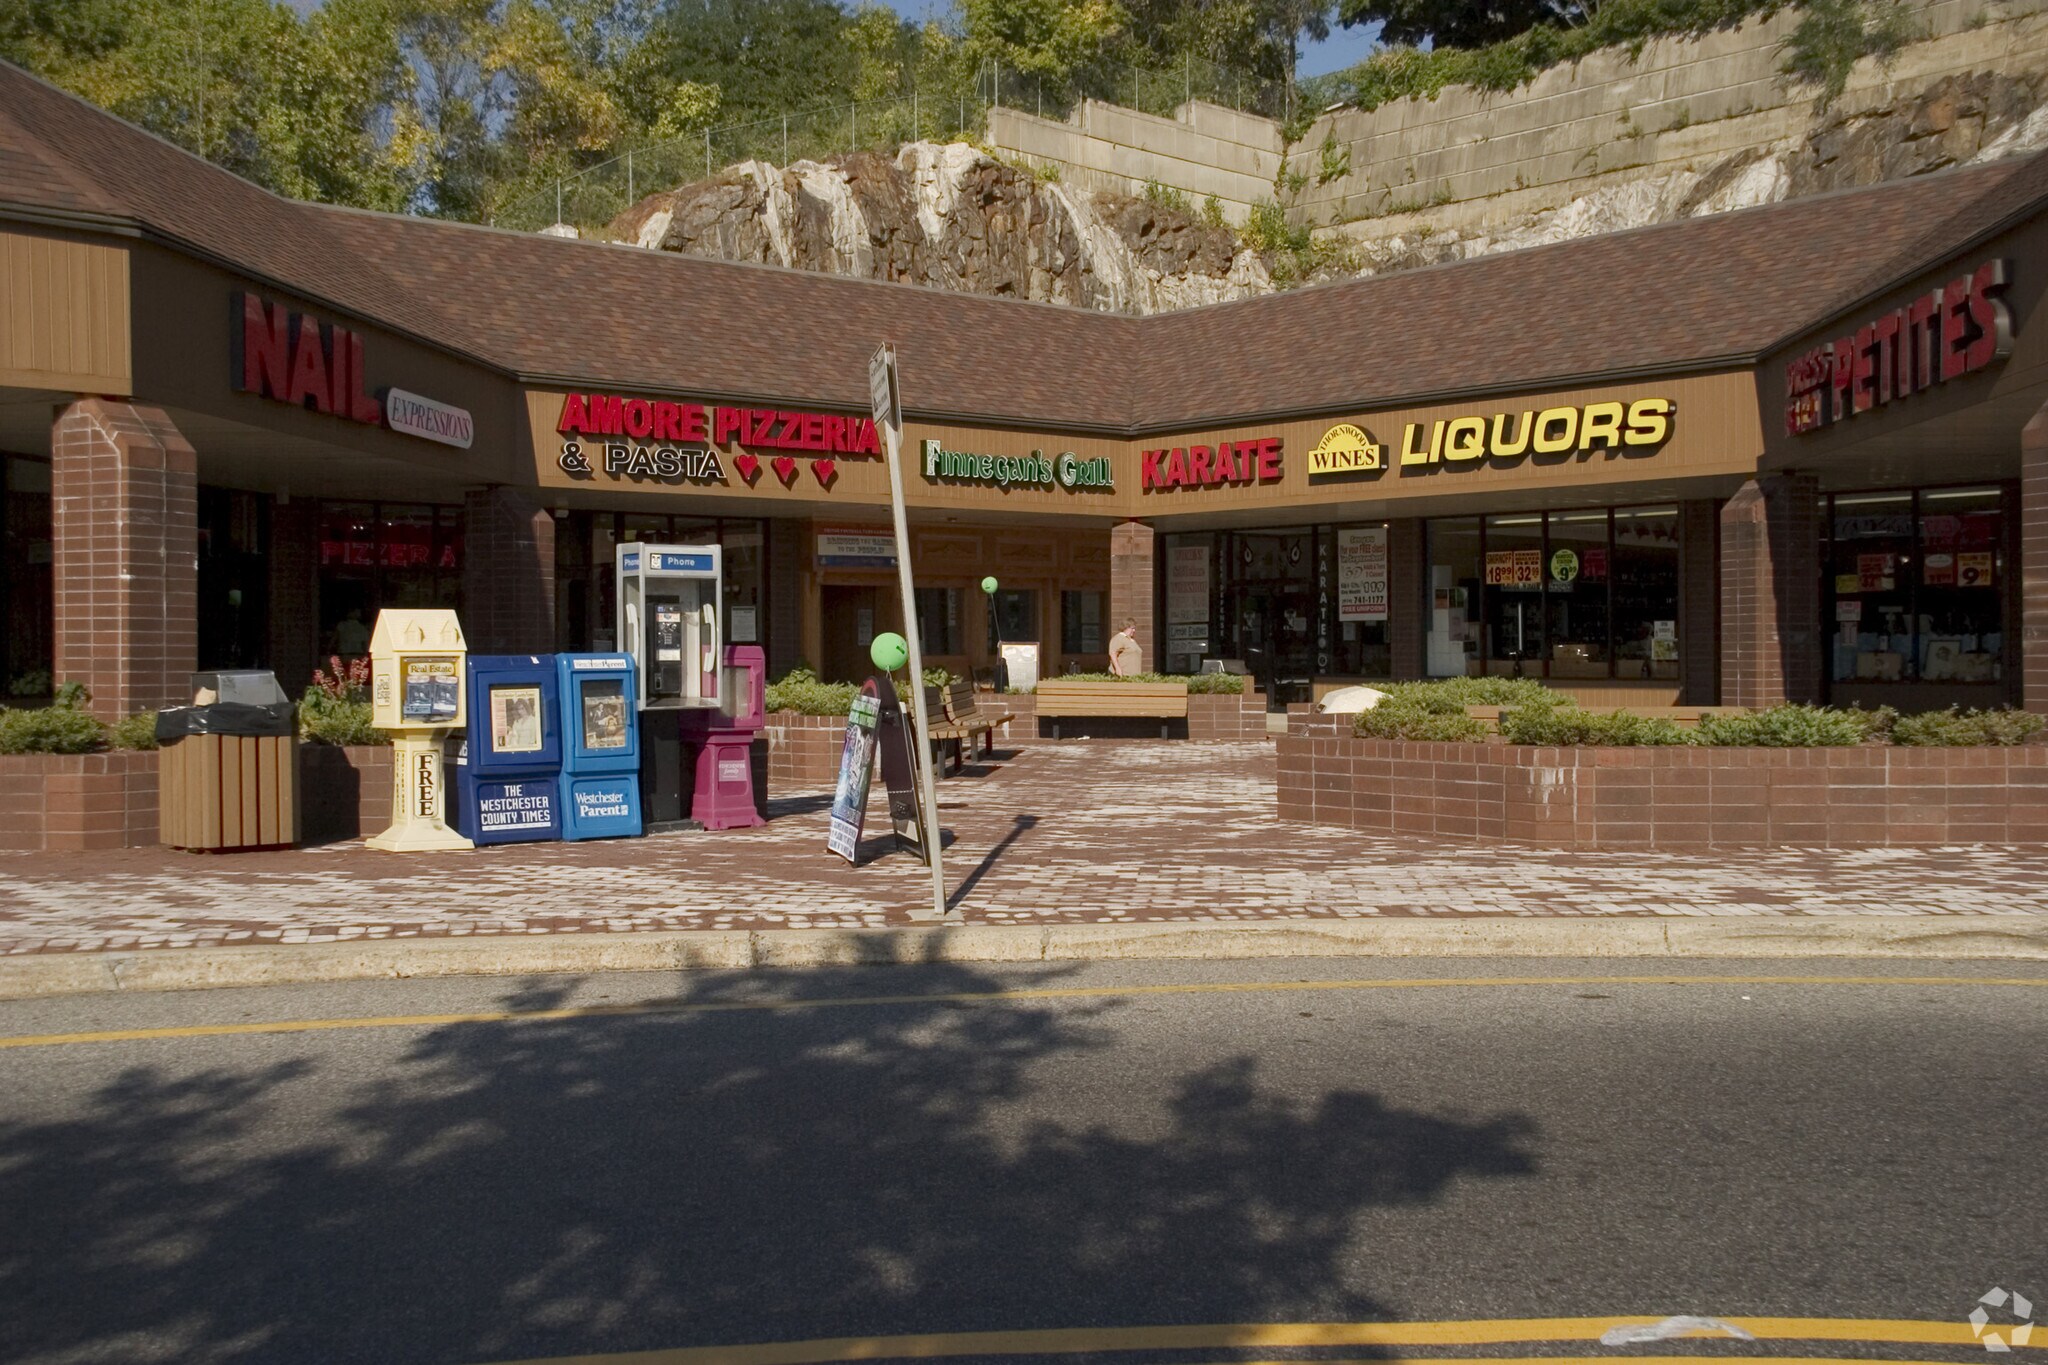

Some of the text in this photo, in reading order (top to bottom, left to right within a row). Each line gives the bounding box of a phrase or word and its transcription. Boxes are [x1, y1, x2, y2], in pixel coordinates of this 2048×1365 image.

[1832, 259, 2007, 421] PETITES
[242, 291, 381, 425] NAIL
[391, 396, 471, 441] EXPRESSIONS
[558, 392, 880, 454] AMORE PIZZERIA
[1401, 398, 1671, 466] LIQUORS
[1320, 426, 1366, 450] THORNWOOD
[559, 442, 726, 478] & PASTA
[1061, 452, 1115, 487] Grill
[1142, 438, 1281, 488] KARATE
[1313, 448, 1375, 469] WINES
[667, 557, 695, 567] Phone
[1319, 544, 1328, 635] KARATE
[1354, 596, 1384, 604] 741-1177
[411, 664, 452, 673] Real Estate
[419, 755, 434, 816] FREE
[504, 785, 523, 797] THE
[575, 791, 624, 804] Westchester
[480, 796, 549, 812] WESTCHESTER
[481, 810, 551, 825] COUNTY TIMES
[580, 805, 621, 817] Parent
